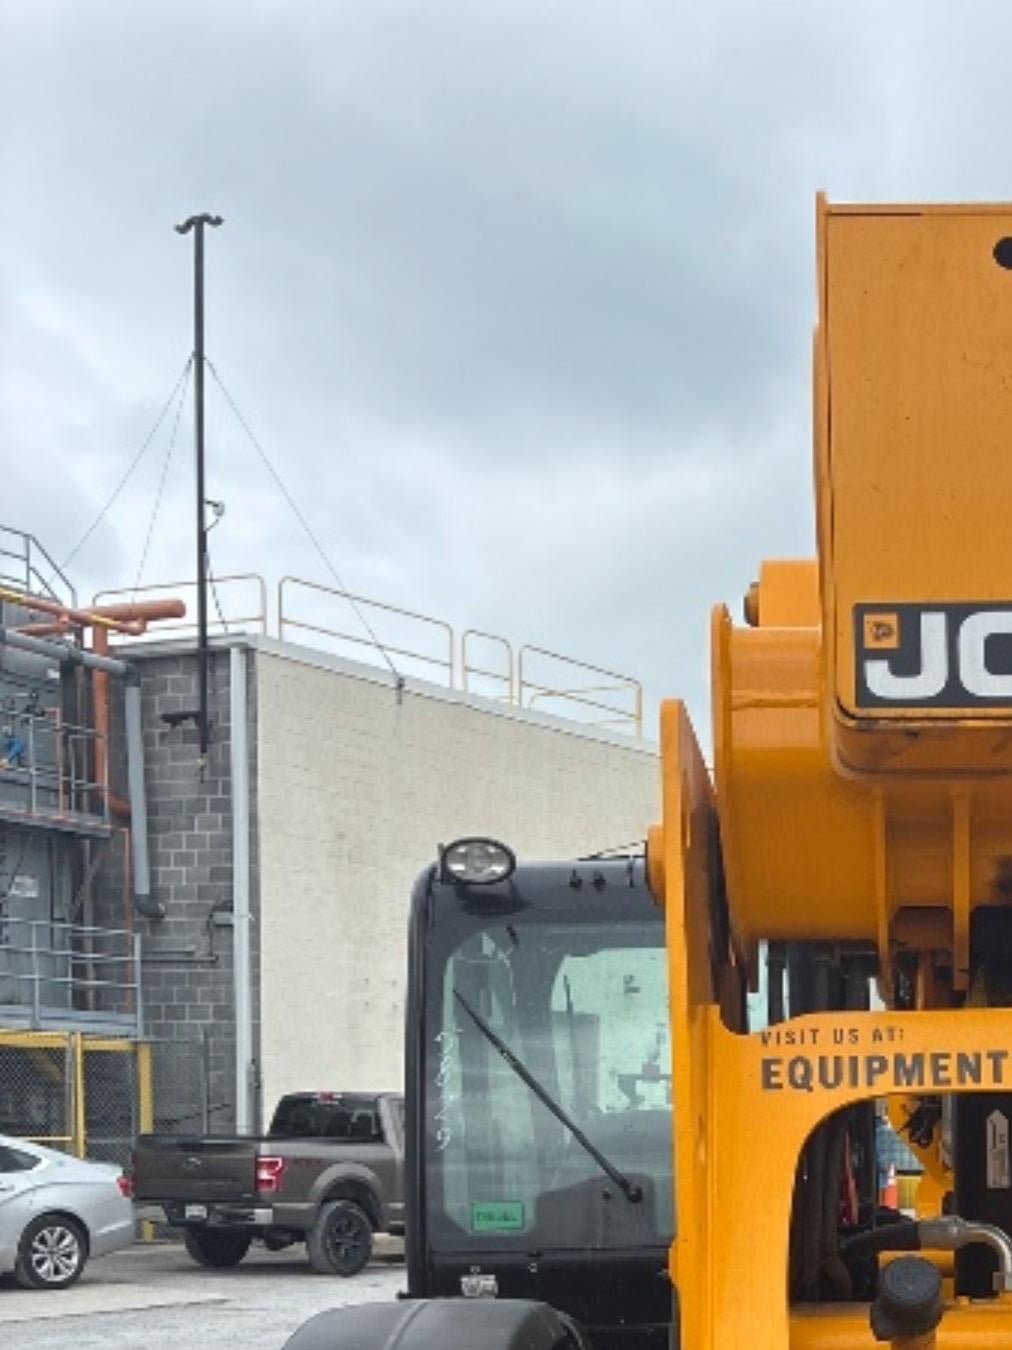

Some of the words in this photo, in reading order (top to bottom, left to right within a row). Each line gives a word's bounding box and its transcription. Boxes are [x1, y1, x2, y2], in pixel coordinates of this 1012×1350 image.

[761, 1029, 820, 1046] VISIT
[833, 1028, 859, 1044] US
[872, 1026, 905, 1043] AT:
